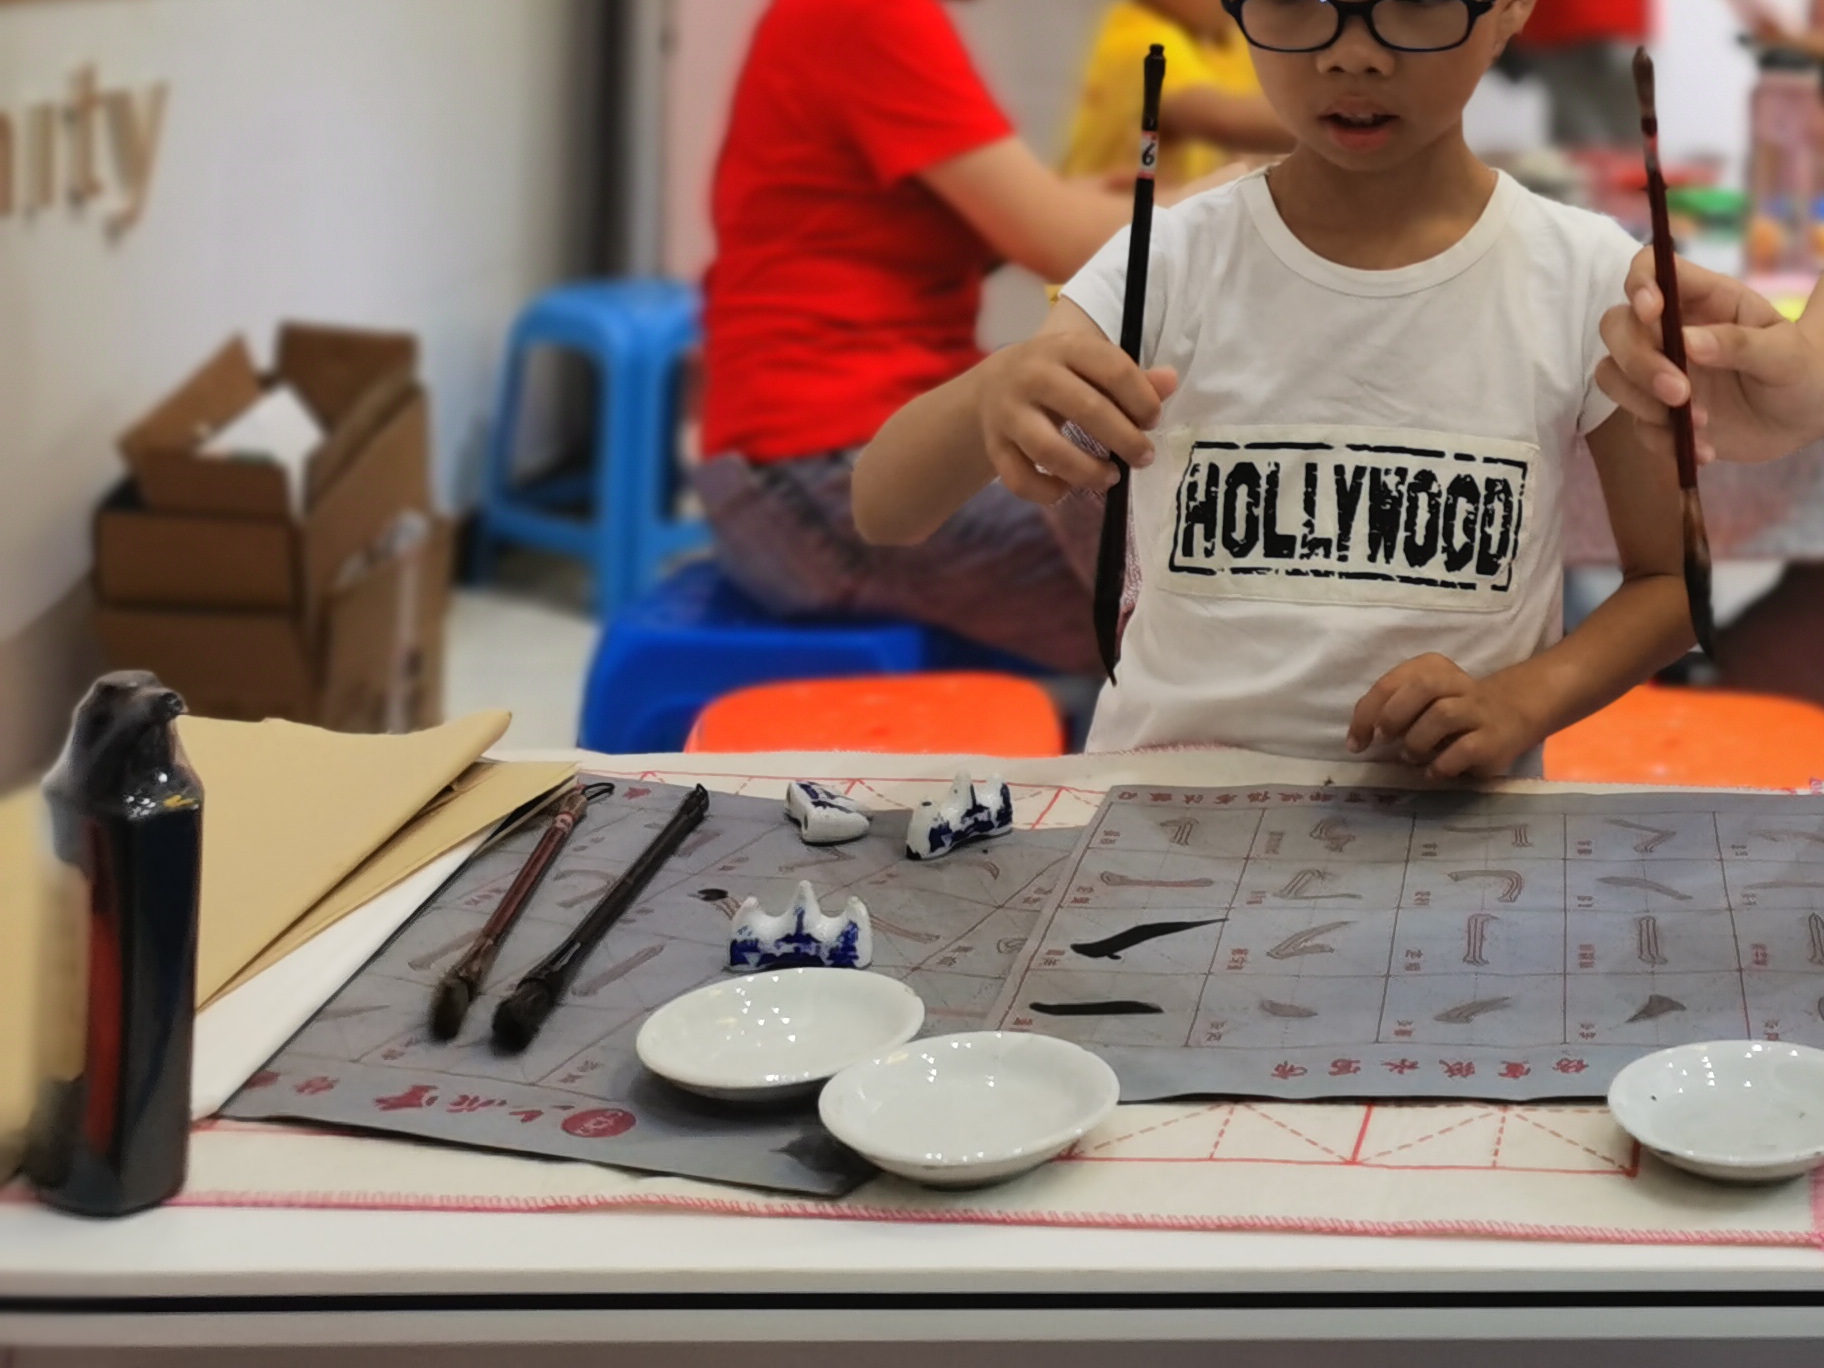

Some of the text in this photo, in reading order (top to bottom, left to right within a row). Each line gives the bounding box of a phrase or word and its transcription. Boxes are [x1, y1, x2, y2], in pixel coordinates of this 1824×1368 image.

[1182, 461, 1514, 576] HOLLYWOOD
[1270, 1057, 1591, 1080] 仿宣纸水写布
